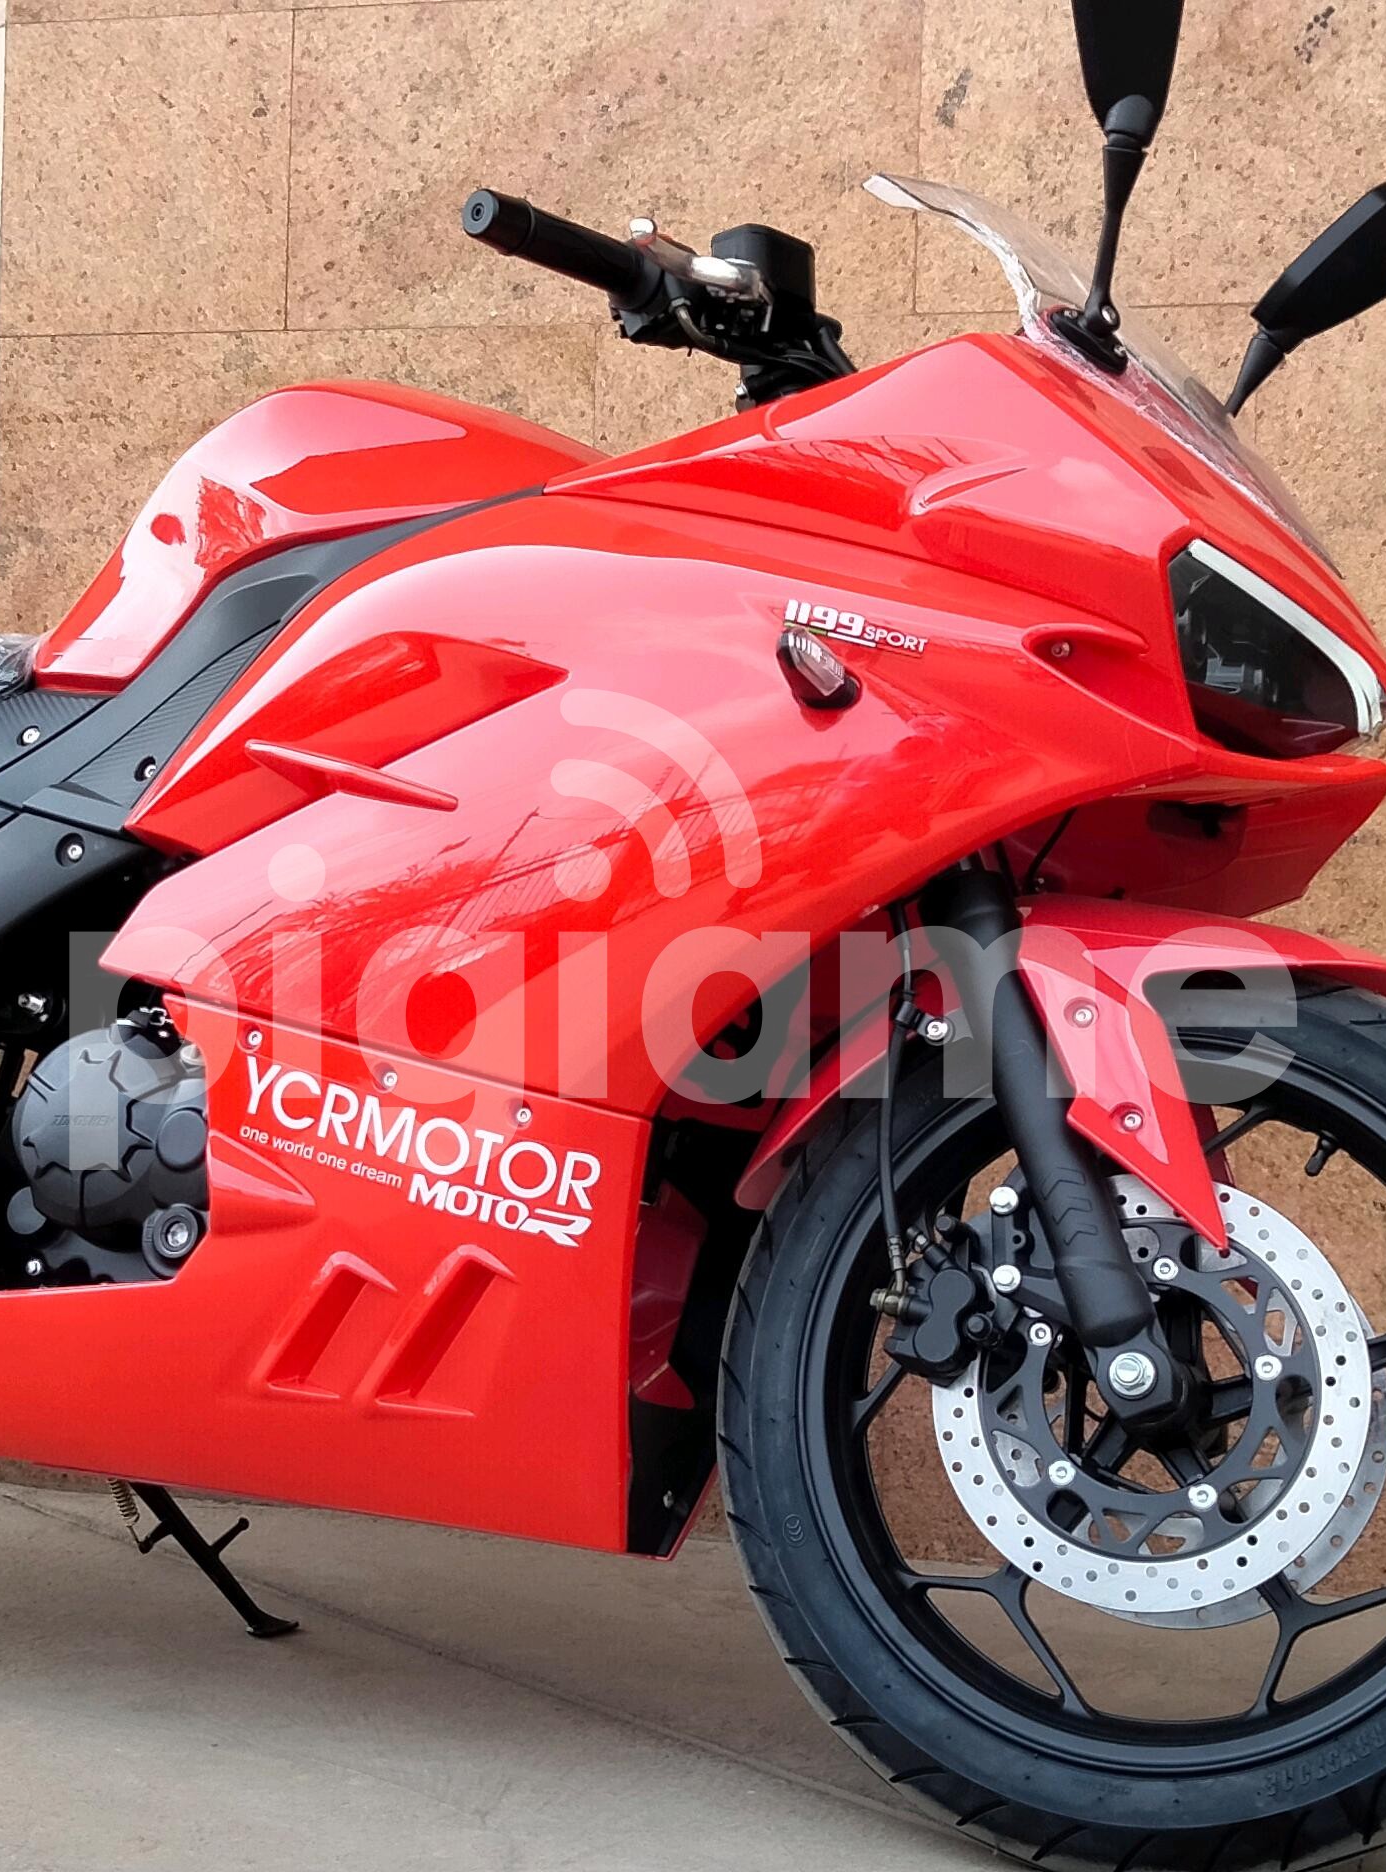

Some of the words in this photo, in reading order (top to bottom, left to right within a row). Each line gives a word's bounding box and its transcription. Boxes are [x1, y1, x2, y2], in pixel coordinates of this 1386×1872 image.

[784, 599, 866, 637] 1199
[863, 625, 928, 653] SPORT
[239, 1125, 269, 1144] one
[272, 1135, 315, 1160] world
[316, 1150, 347, 1170] one
[350, 1161, 402, 1188] dream
[245, 1056, 601, 1210] YCRMOTOR
